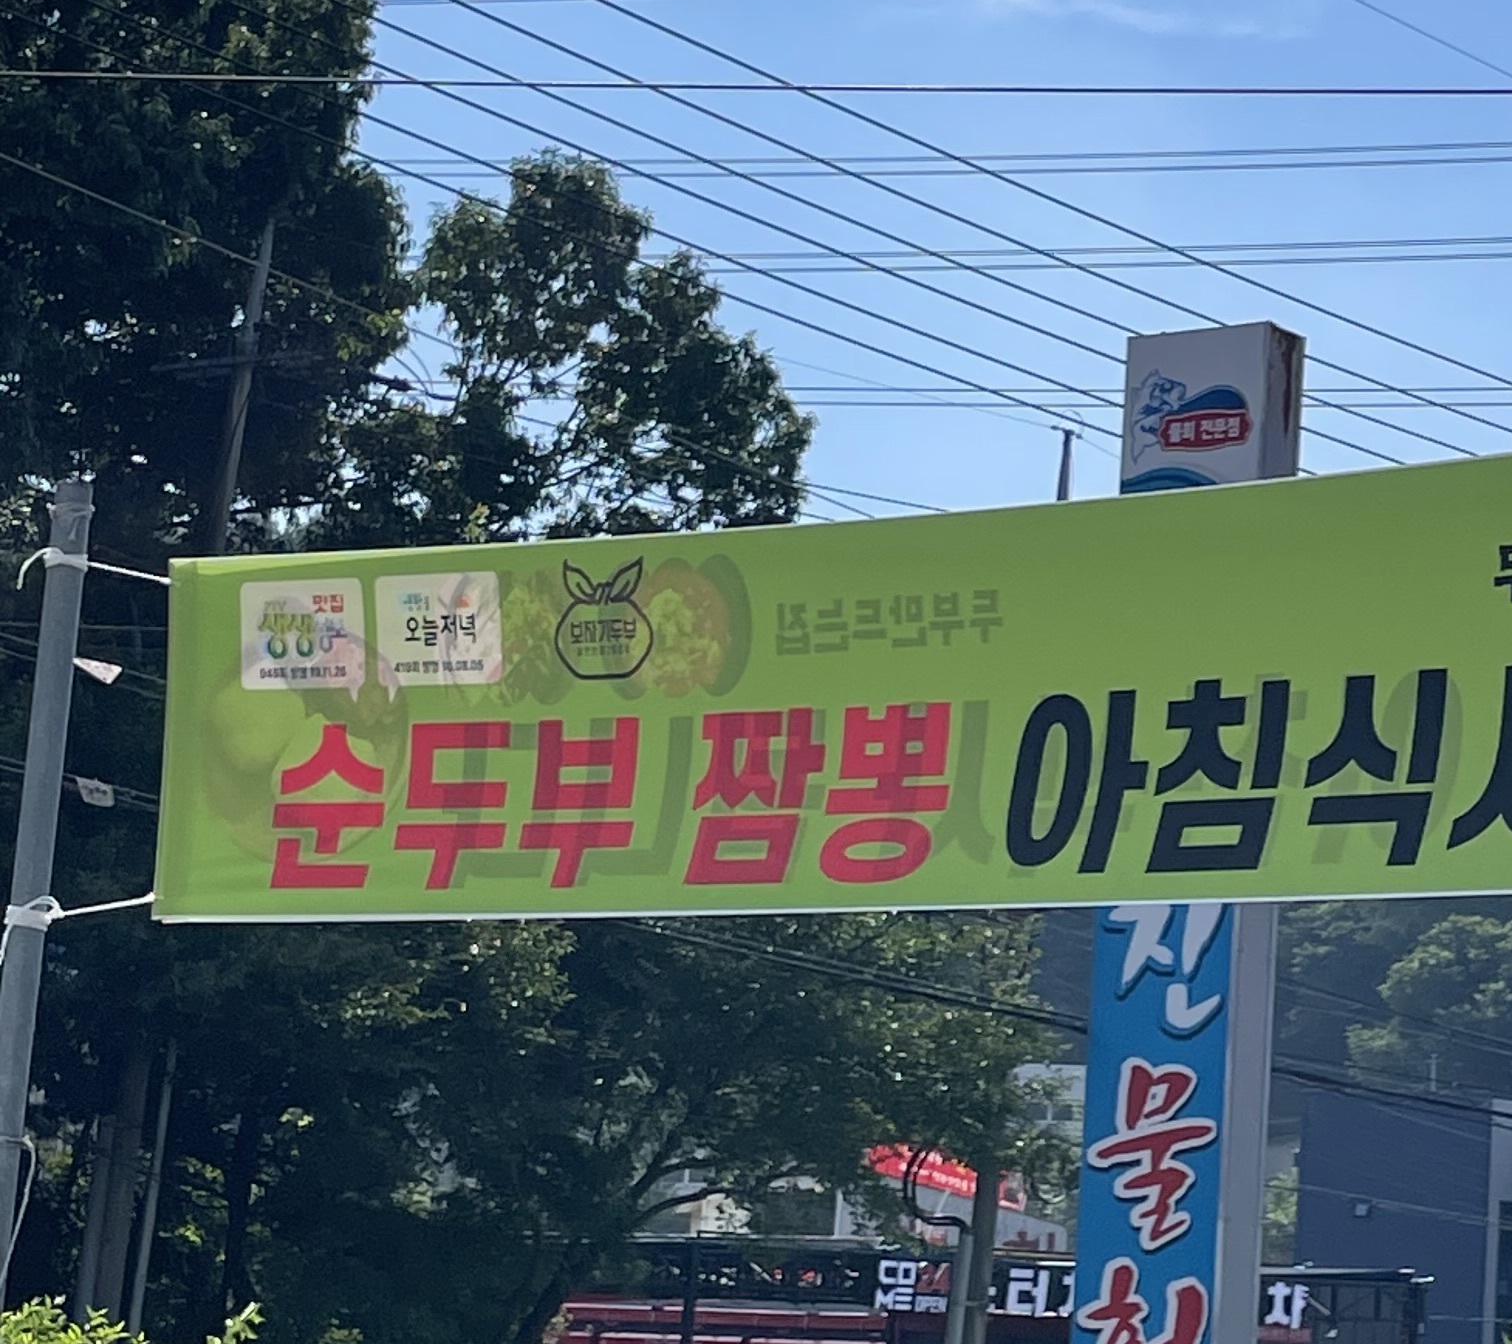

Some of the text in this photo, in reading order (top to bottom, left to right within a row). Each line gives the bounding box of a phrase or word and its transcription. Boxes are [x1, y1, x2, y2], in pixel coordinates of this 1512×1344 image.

[404, 613, 477, 647] 오늘저녁
[269, 716, 641, 890] 순두부
[683, 701, 952, 886] 짬뽕
